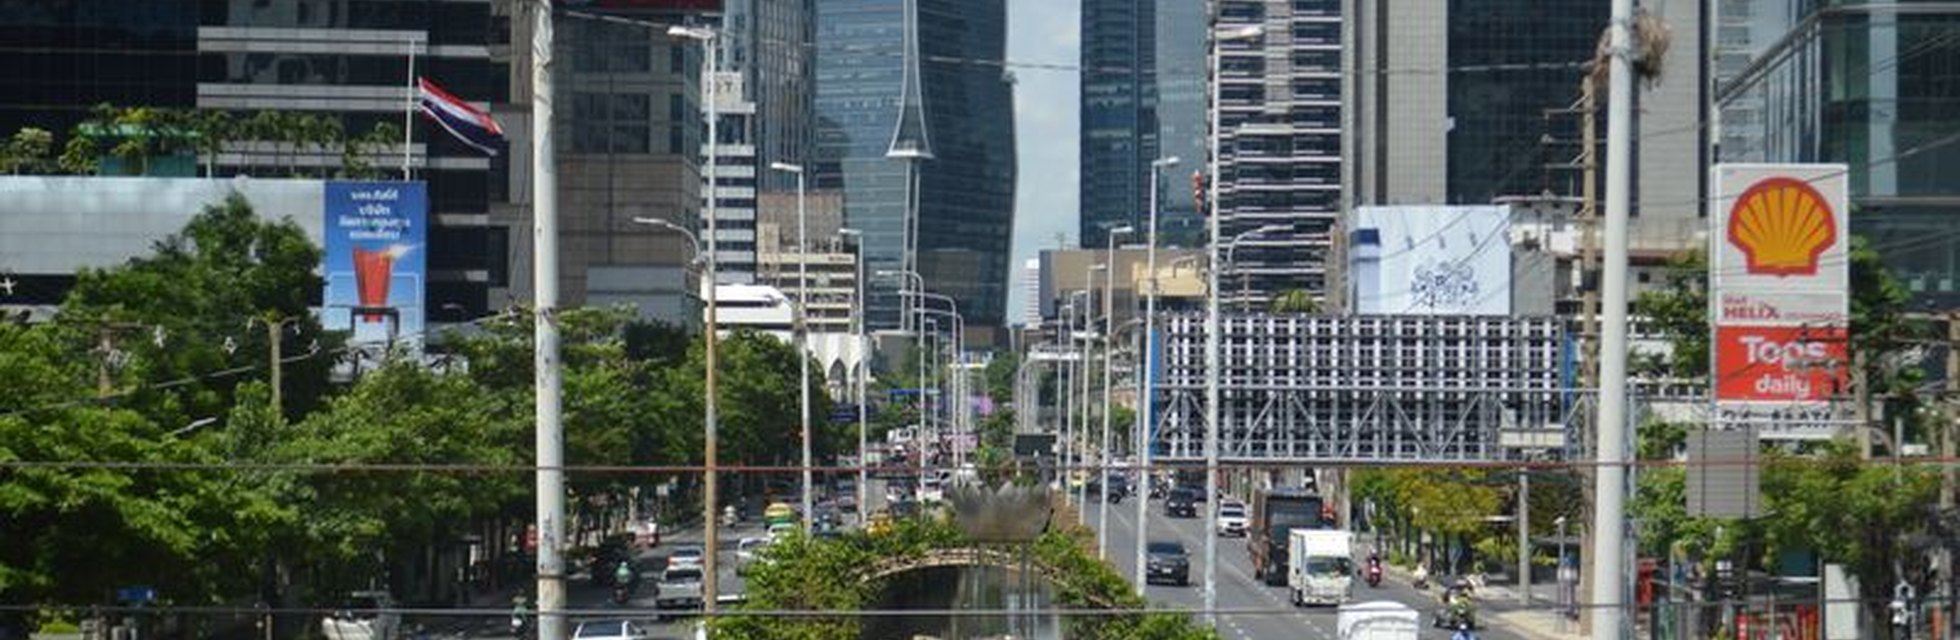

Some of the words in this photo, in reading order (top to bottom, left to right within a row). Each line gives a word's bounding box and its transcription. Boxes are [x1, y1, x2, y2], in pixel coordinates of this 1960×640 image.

[1724, 303, 1779, 319] HELIX
[1738, 336, 1827, 372] Tops
[1755, 373, 1810, 399] daily
